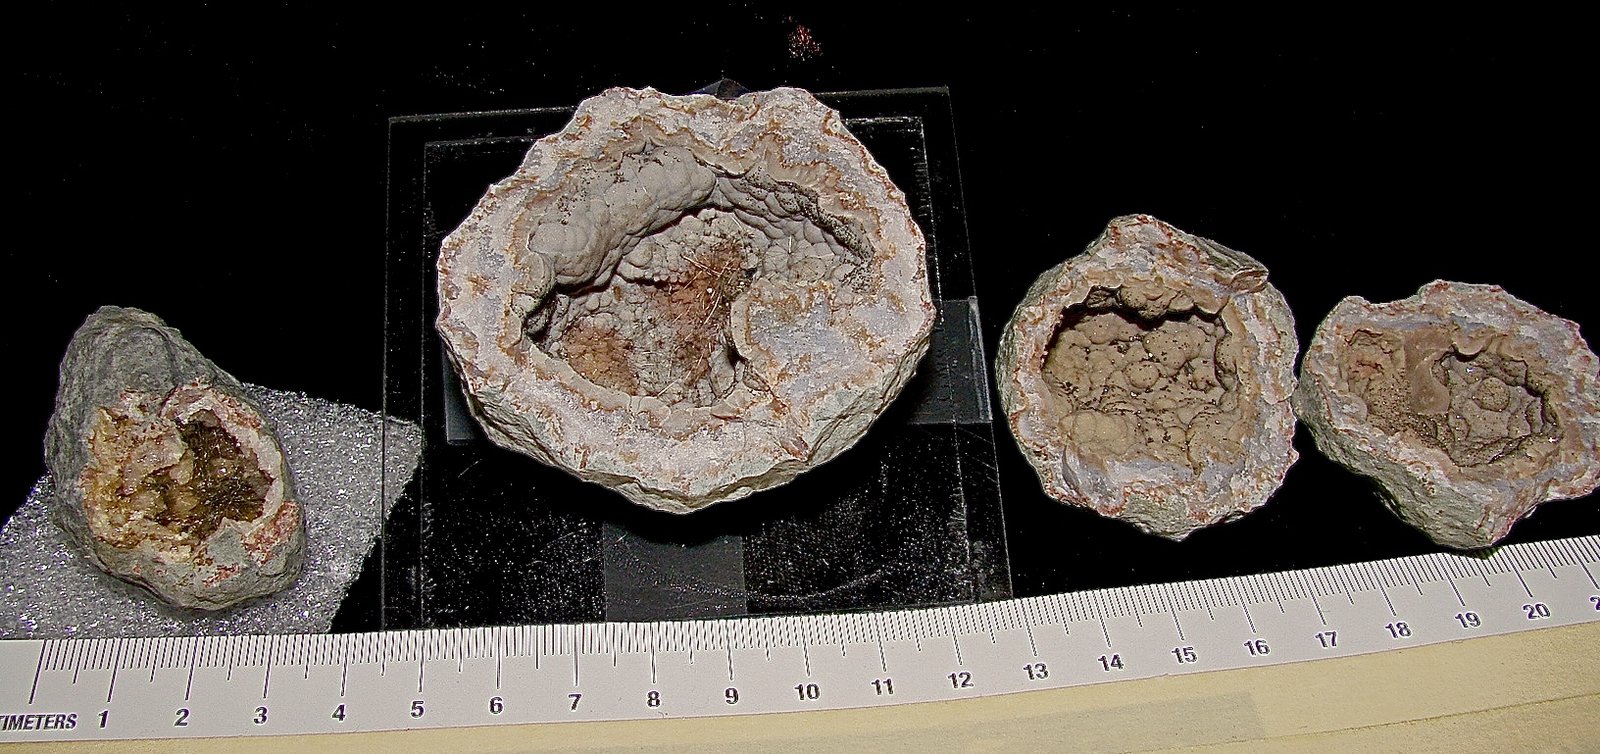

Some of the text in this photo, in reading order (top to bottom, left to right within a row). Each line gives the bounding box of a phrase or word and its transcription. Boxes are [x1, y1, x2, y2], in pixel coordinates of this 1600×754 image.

[98, 710, 109, 729] 1
[174, 708, 190, 727] 2
[253, 706, 268, 725] 3
[331, 704, 346, 722] 4
[410, 700, 424, 718] 5
[489, 696, 504, 714] 6
[568, 693, 582, 711] 7
[646, 690, 661, 708] 8
[725, 687, 739, 705] 9
[794, 683, 820, 701] 10
[871, 678, 894, 696] 11
[947, 672, 973, 689] 12
[1022, 663, 1049, 680] 13
[1097, 654, 1125, 672] 14
[1171, 646, 1197, 664] 15
[1243, 639, 1271, 656] 16
[1314, 630, 1337, 648] 17
[1385, 622, 1412, 639] 18
[1454, 612, 1481, 629] 19
[1522, 603, 1551, 620] 20
